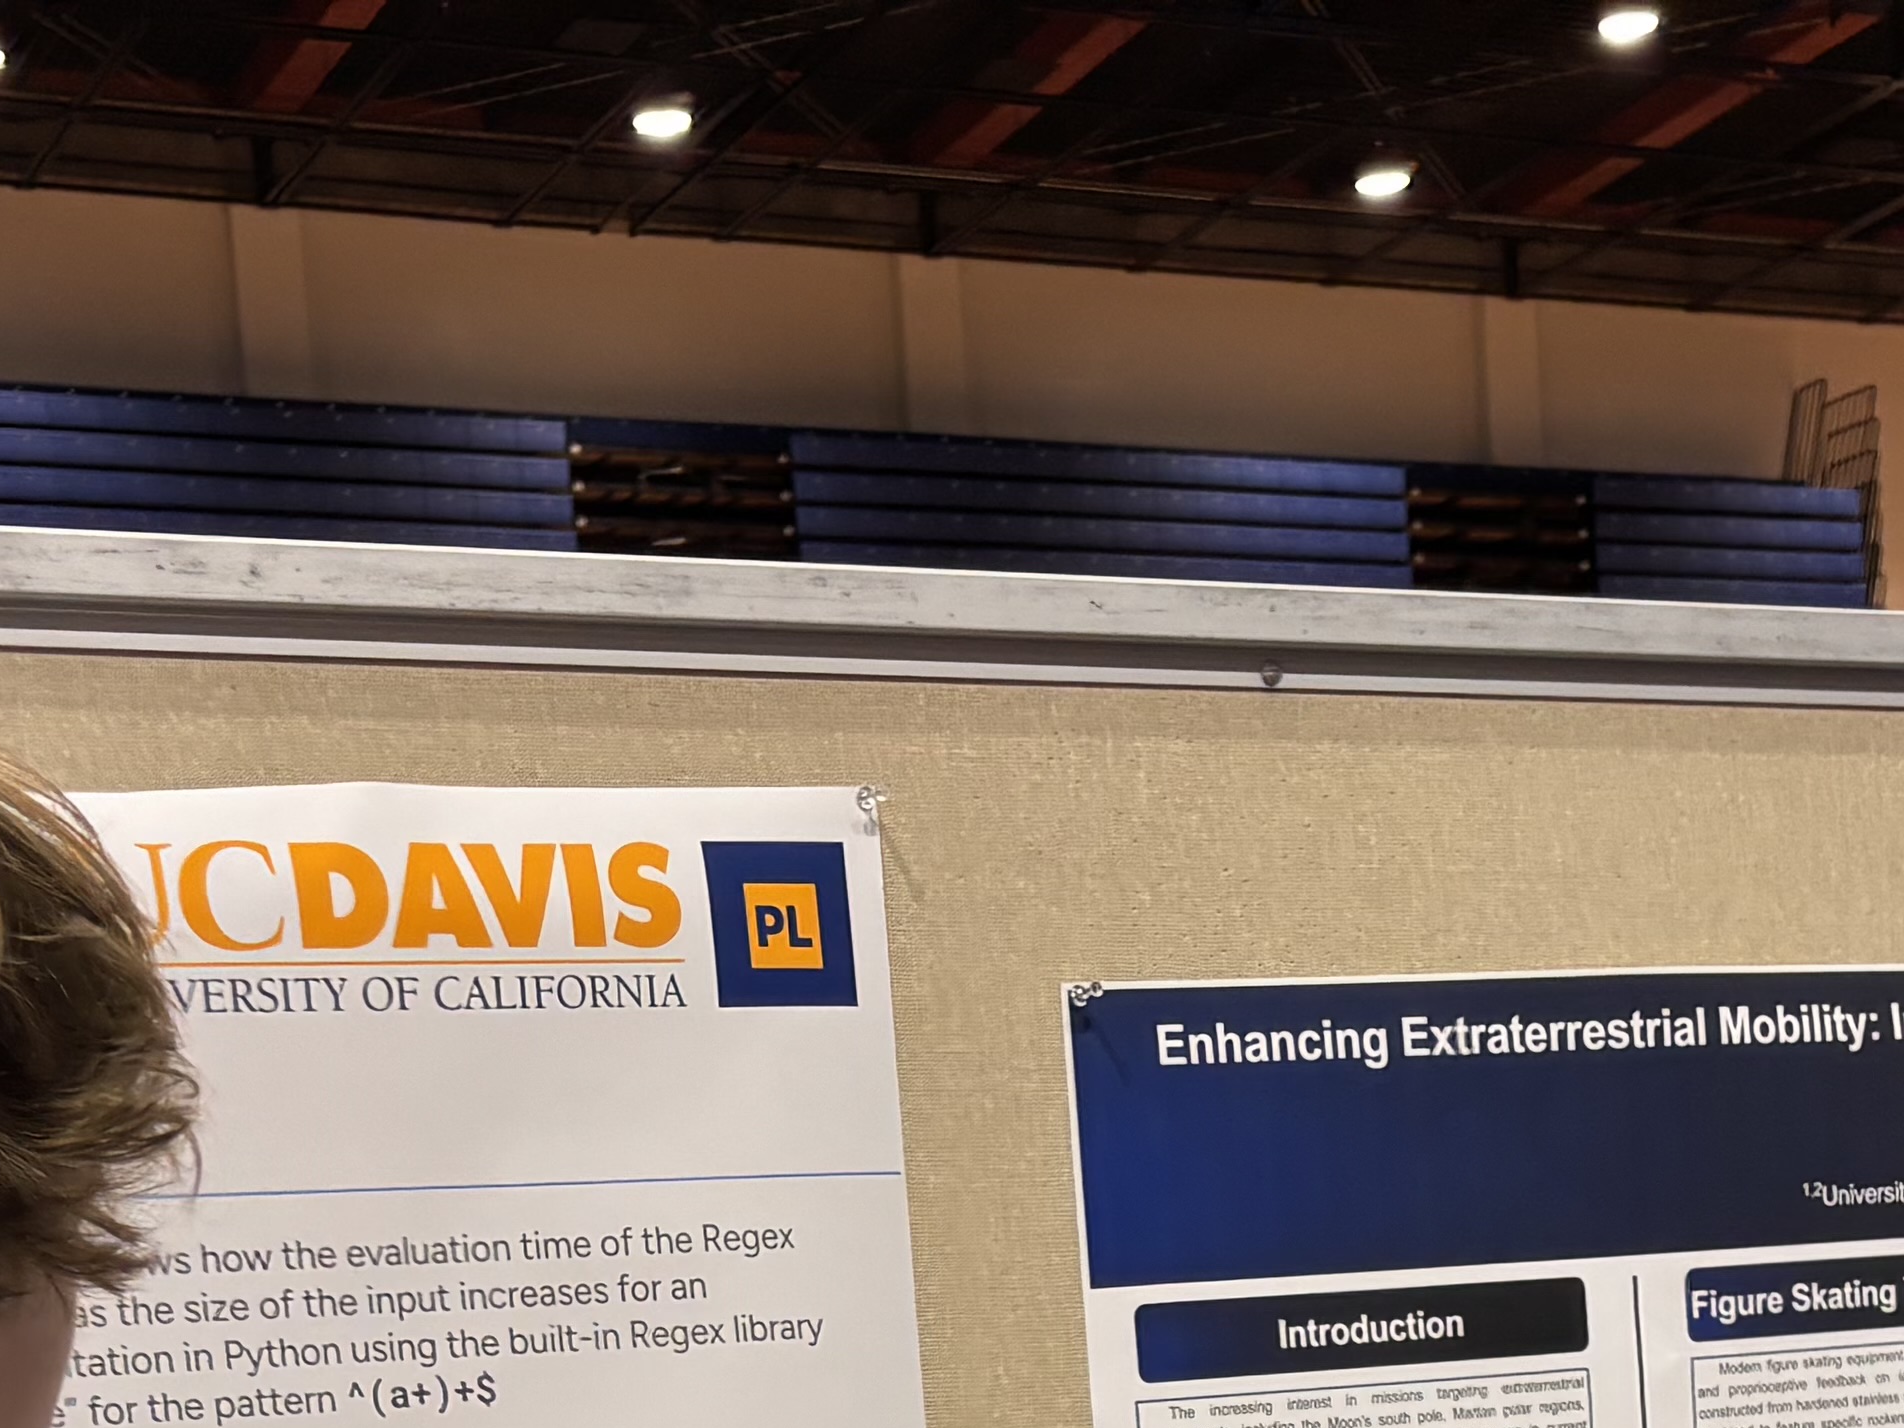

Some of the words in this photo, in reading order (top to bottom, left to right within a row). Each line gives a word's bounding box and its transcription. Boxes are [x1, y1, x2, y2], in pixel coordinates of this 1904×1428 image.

[755, 903, 813, 948] PL
[363, 977, 418, 1011] OF
[434, 973, 687, 1009] CALIFORNIA
[1156, 1013, 1389, 1068] Enhancing
[1402, 1004, 1706, 1057] Extraterrestrial
[1719, 1004, 1881, 1053] Mobility:
[345, 1234, 512, 1266] evaluation
[519, 1230, 592, 1259] time
[601, 1226, 635, 1256] of
[641, 1223, 693, 1254] the
[701, 1223, 795, 1258] Regex
[1691, 1287, 1783, 1324] Figure
[1792, 1277, 1897, 1312] Skating
[223, 1336, 342, 1377] Python
[351, 1334, 438, 1371] using
[446, 1327, 500, 1358] the
[508, 1322, 621, 1355] built-in
[629, 1319, 726, 1355] Regex
[734, 1312, 824, 1353] library
[1278, 1312, 1465, 1349] Introduction
[88, 1395, 141, 1427] for
[148, 1391, 205, 1423] the
[214, 1384, 338, 1426] pattern
